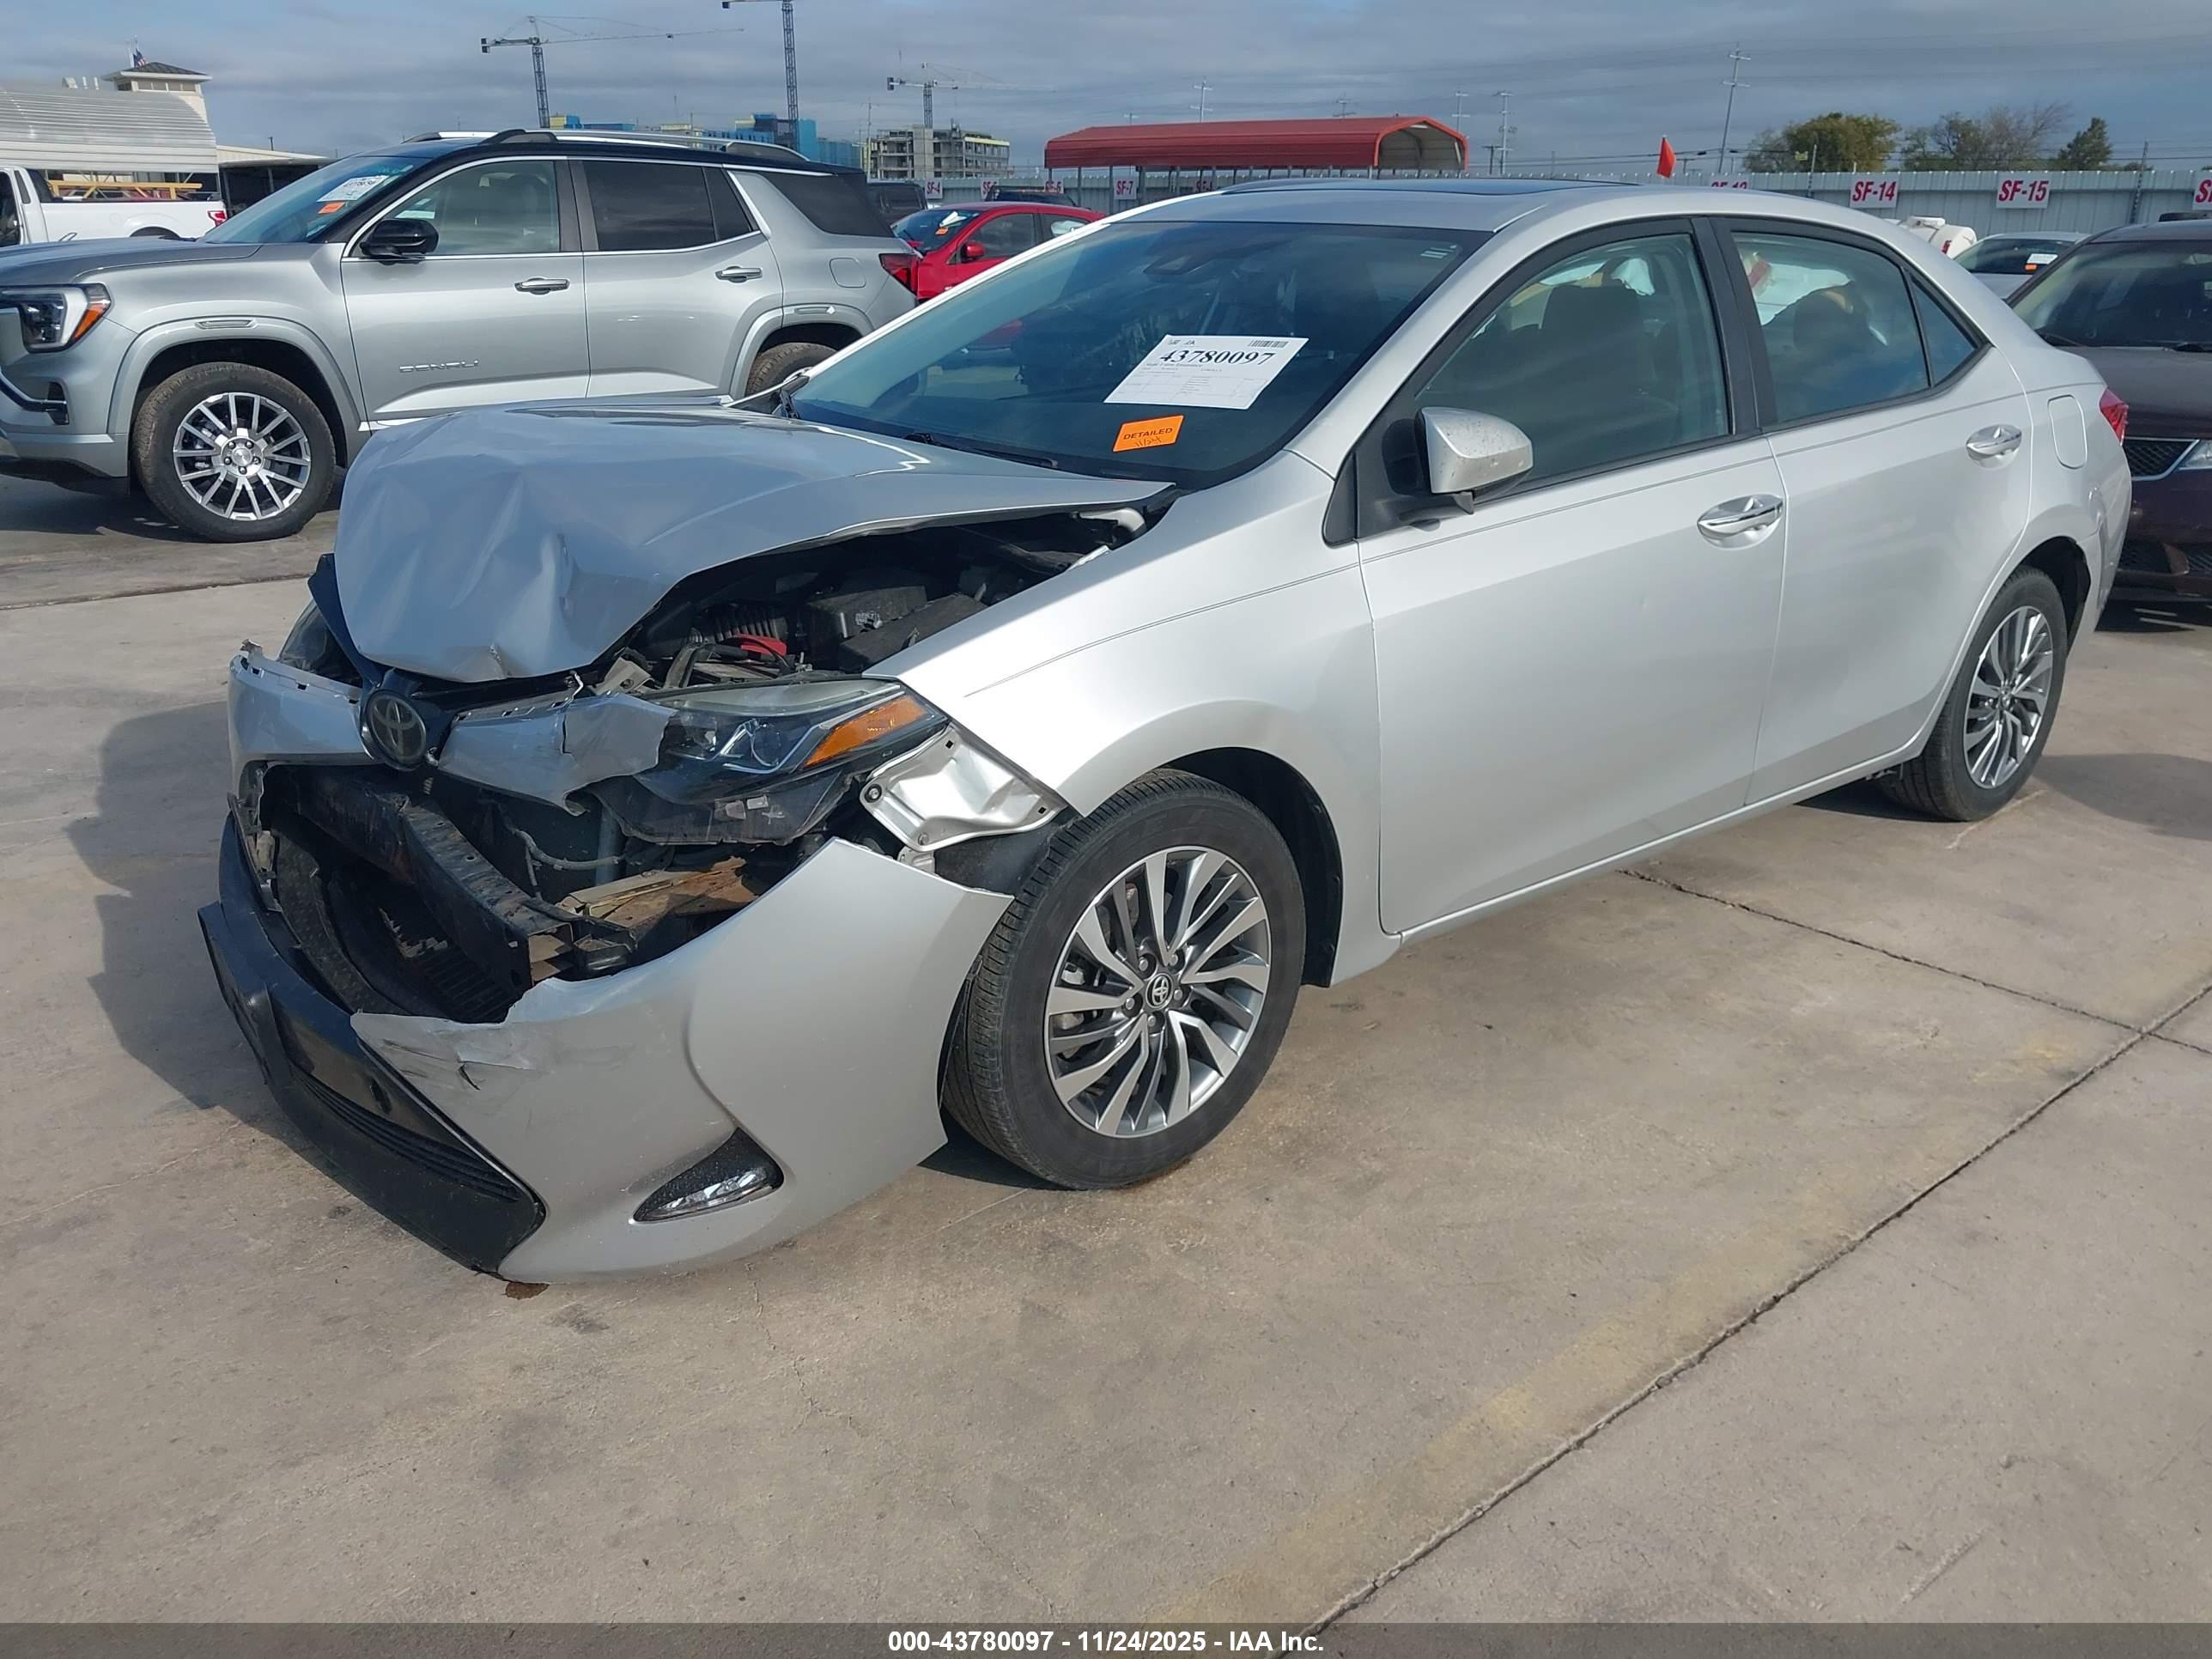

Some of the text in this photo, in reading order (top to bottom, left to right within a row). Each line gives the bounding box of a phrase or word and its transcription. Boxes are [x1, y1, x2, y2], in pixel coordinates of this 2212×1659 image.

[1115, 180, 1134, 195] SF-7
[1852, 180, 1897, 202] SF-14
[1998, 179, 2049, 202] SF-15
[1159, 349, 1276, 366] 43780097
[1123, 428, 1173, 440] DETAILED
